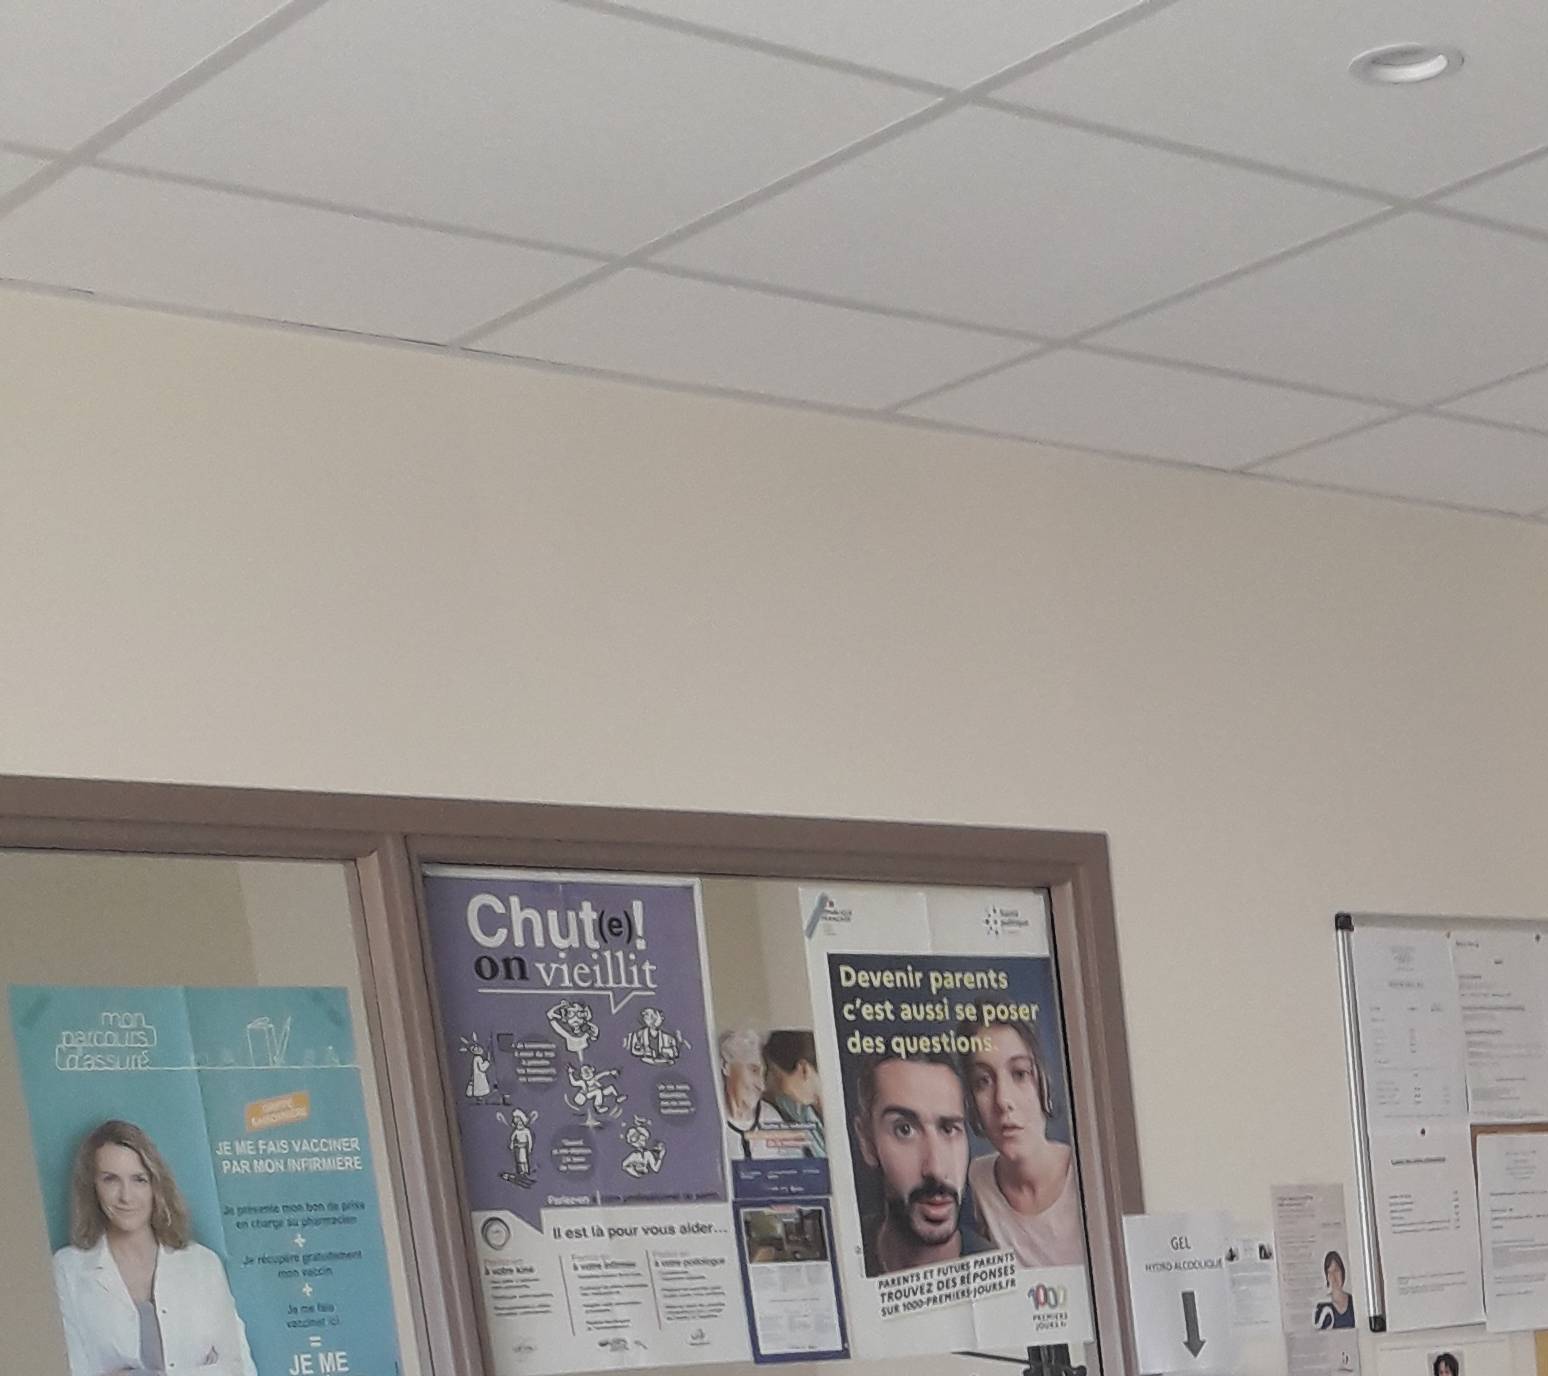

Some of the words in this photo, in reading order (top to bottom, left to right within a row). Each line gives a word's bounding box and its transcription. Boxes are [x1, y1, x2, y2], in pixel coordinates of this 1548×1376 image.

[474, 955, 529, 981] on
[535, 951, 658, 988] vieillit
[839, 965, 924, 988] Devenir
[929, 968, 1009, 994] parents
[102, 1012, 145, 1028] mon
[843, 998, 895, 1021] c'est
[900, 998, 950, 1021] aussi
[955, 1005, 978, 1021] se
[983, 1003, 1040, 1027] poser
[847, 1030, 885, 1053] des
[216, 1142, 232, 1155] JE
[235, 1141, 254, 1154] ME
[258, 1139, 289, 1154] FAIS
[291, 1137, 361, 1152] VACCINER
[222, 1160, 250, 1174] PAR
[253, 1159, 285, 1173] MON
[553, 1226, 563, 1239] Il
[565, 1225, 588, 1239] est
[592, 1221, 605, 1238] là
[608, 1225, 639, 1242] pour
[642, 1223, 676, 1236] vous
[1170, 1236, 1192, 1251] GEL
[878, 1273, 921, 1290] PARENTS
[923, 1269, 935, 1281] ET
[937, 1261, 971, 1277] FUTURS
[973, 1253, 1016, 1271] PARENTS
[880, 1283, 933, 1305] TROUVEZ
[937, 1277, 957, 1292] DES
[960, 1264, 1016, 1287] RÉPONSES
[881, 1305, 899, 1318] SUR
[289, 1353, 314, 1376] JE
[319, 1352, 350, 1373] ME
